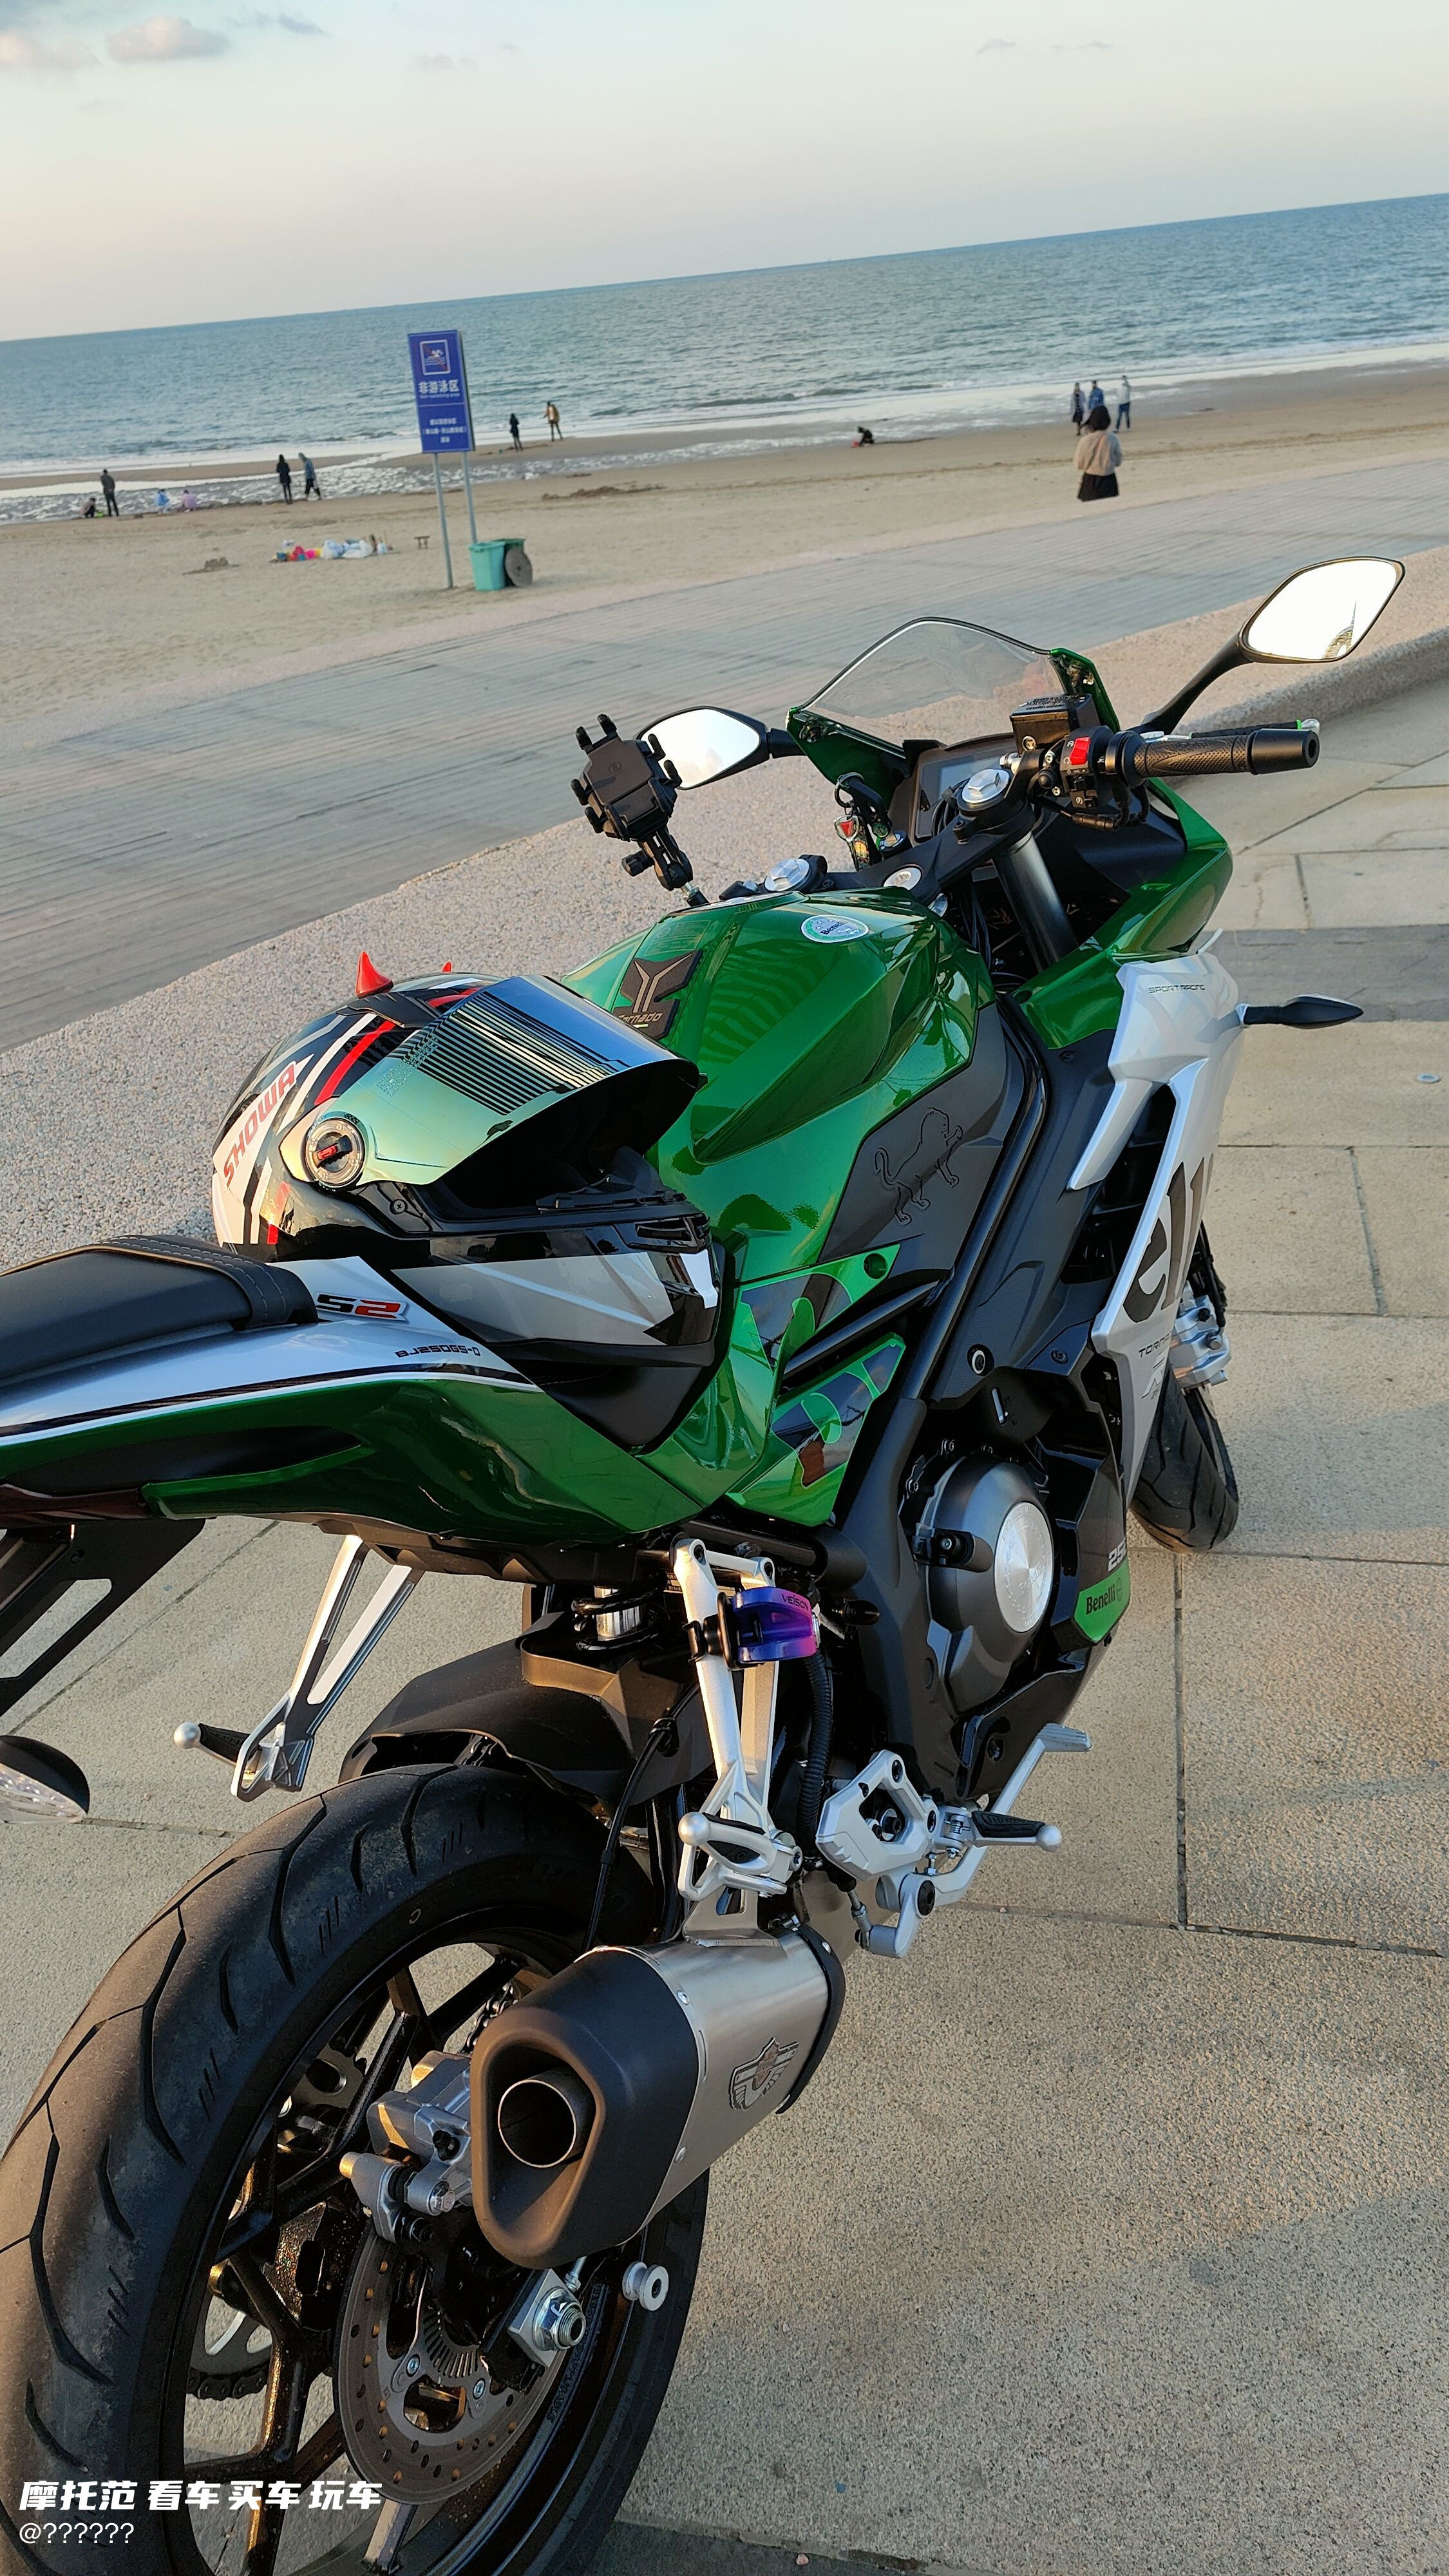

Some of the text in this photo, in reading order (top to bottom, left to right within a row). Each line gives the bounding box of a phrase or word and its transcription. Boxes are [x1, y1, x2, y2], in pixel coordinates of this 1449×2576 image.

[1148, 985, 1179, 993] SPORT
[223, 1063, 296, 1188] SHOWA
[315, 1294, 402, 1319] S2
[1085, 1584, 1116, 1615] Benelli
